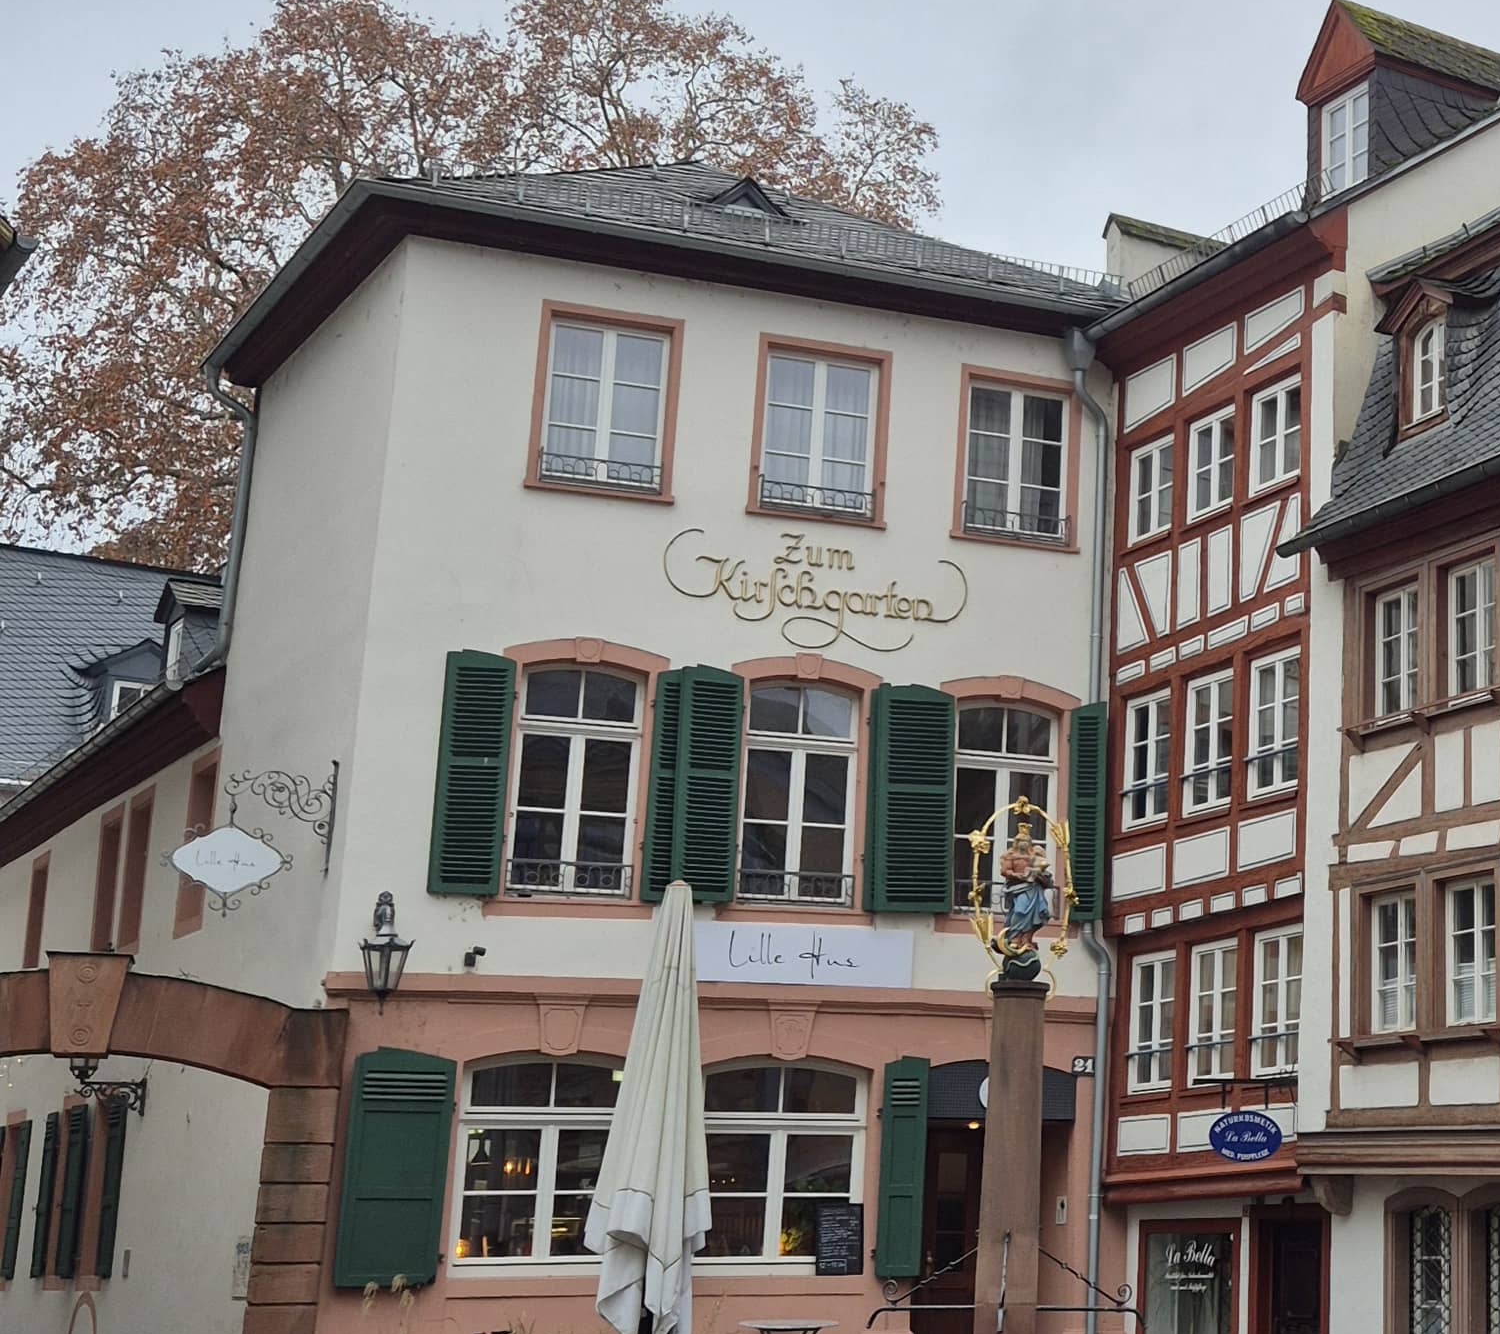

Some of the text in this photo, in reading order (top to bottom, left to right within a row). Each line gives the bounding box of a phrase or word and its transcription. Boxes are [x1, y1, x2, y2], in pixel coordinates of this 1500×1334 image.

[773, 532, 856, 571] Zum
[728, 929, 861, 979] Lille Hus
[1073, 1058, 1095, 1073] 21
[1213, 1114, 1279, 1135] NATURKOSMETIK
[1240, 1130, 1268, 1143] Bella
[1166, 1239, 1216, 1267] La Bella
